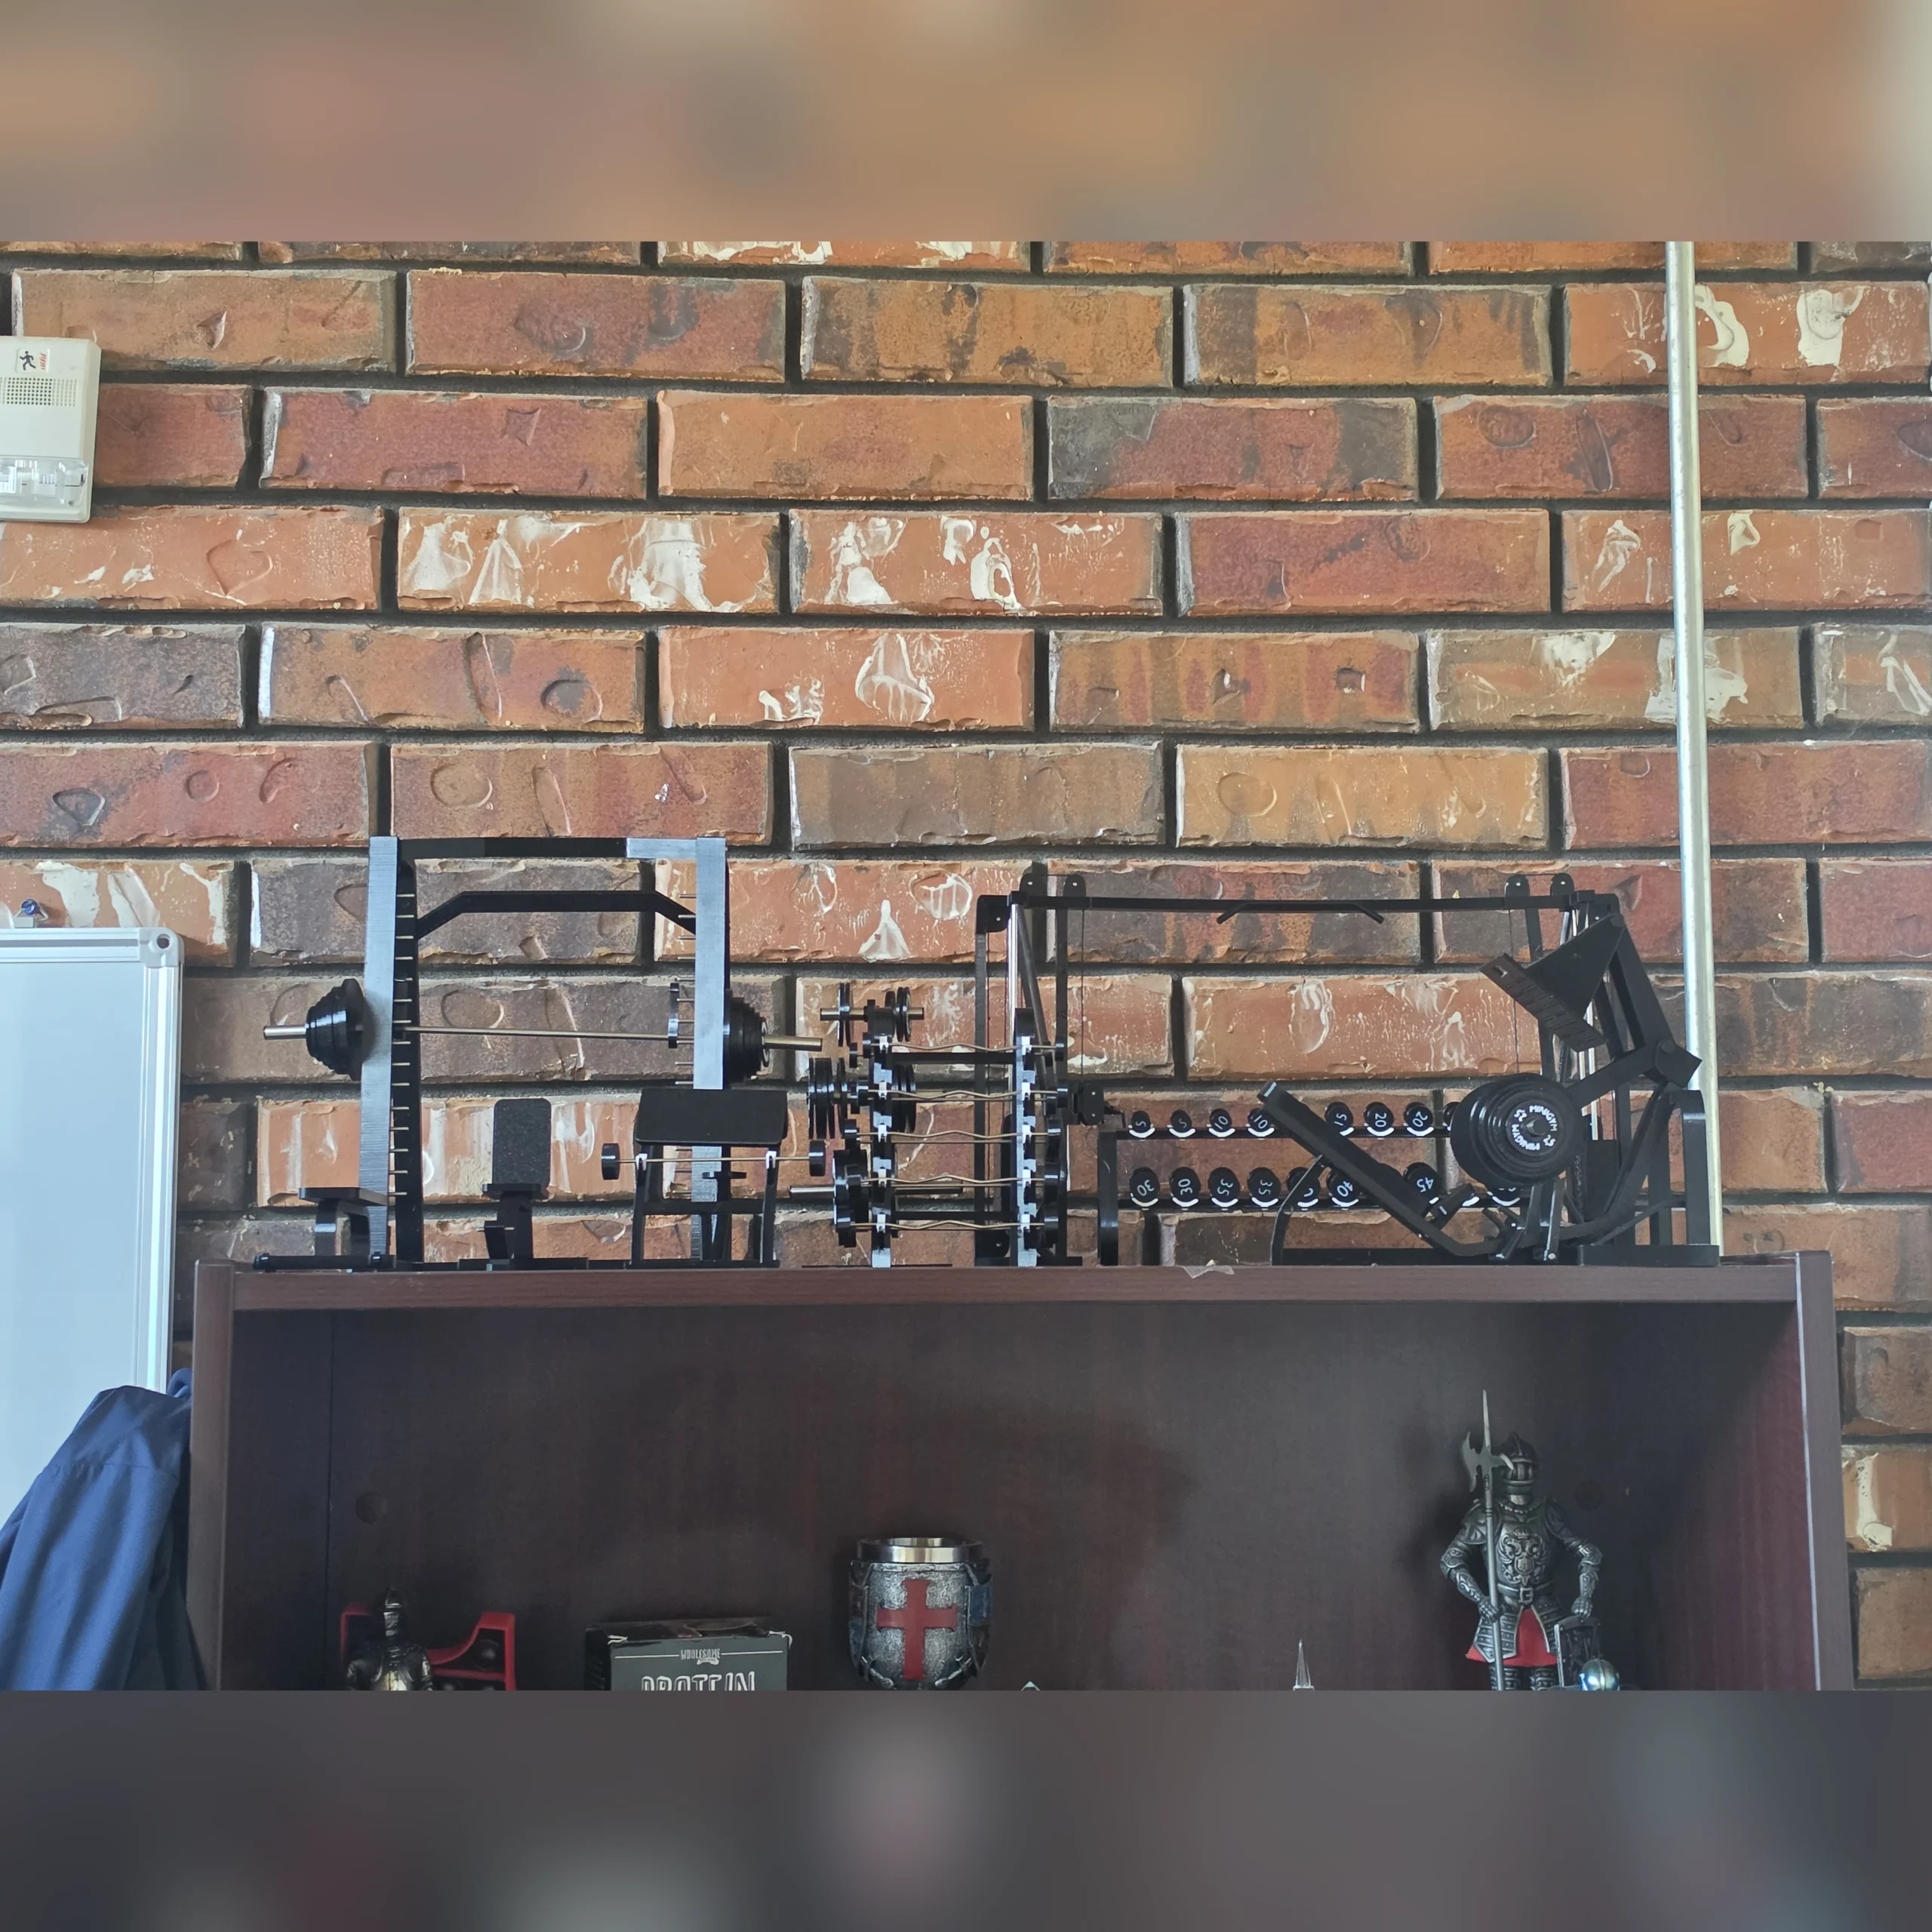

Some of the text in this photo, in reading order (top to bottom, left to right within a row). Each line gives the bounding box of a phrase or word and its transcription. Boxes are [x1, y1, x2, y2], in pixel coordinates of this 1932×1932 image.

[1214, 1115, 1229, 1130] 10
[1254, 1115, 1268, 1129] 10
[1334, 1112, 1347, 1126] 15
[1374, 1112, 1387, 1128] 20
[1412, 1111, 1429, 1128] 20
[1529, 1105, 1558, 1131] MINIGYM
[1137, 1180, 1155, 1196] 30
[1178, 1178, 1192, 1195] 30
[1217, 1178, 1233, 1196] 35
[1258, 1180, 1272, 1195] 35
[1416, 1177, 1434, 1193] 45
